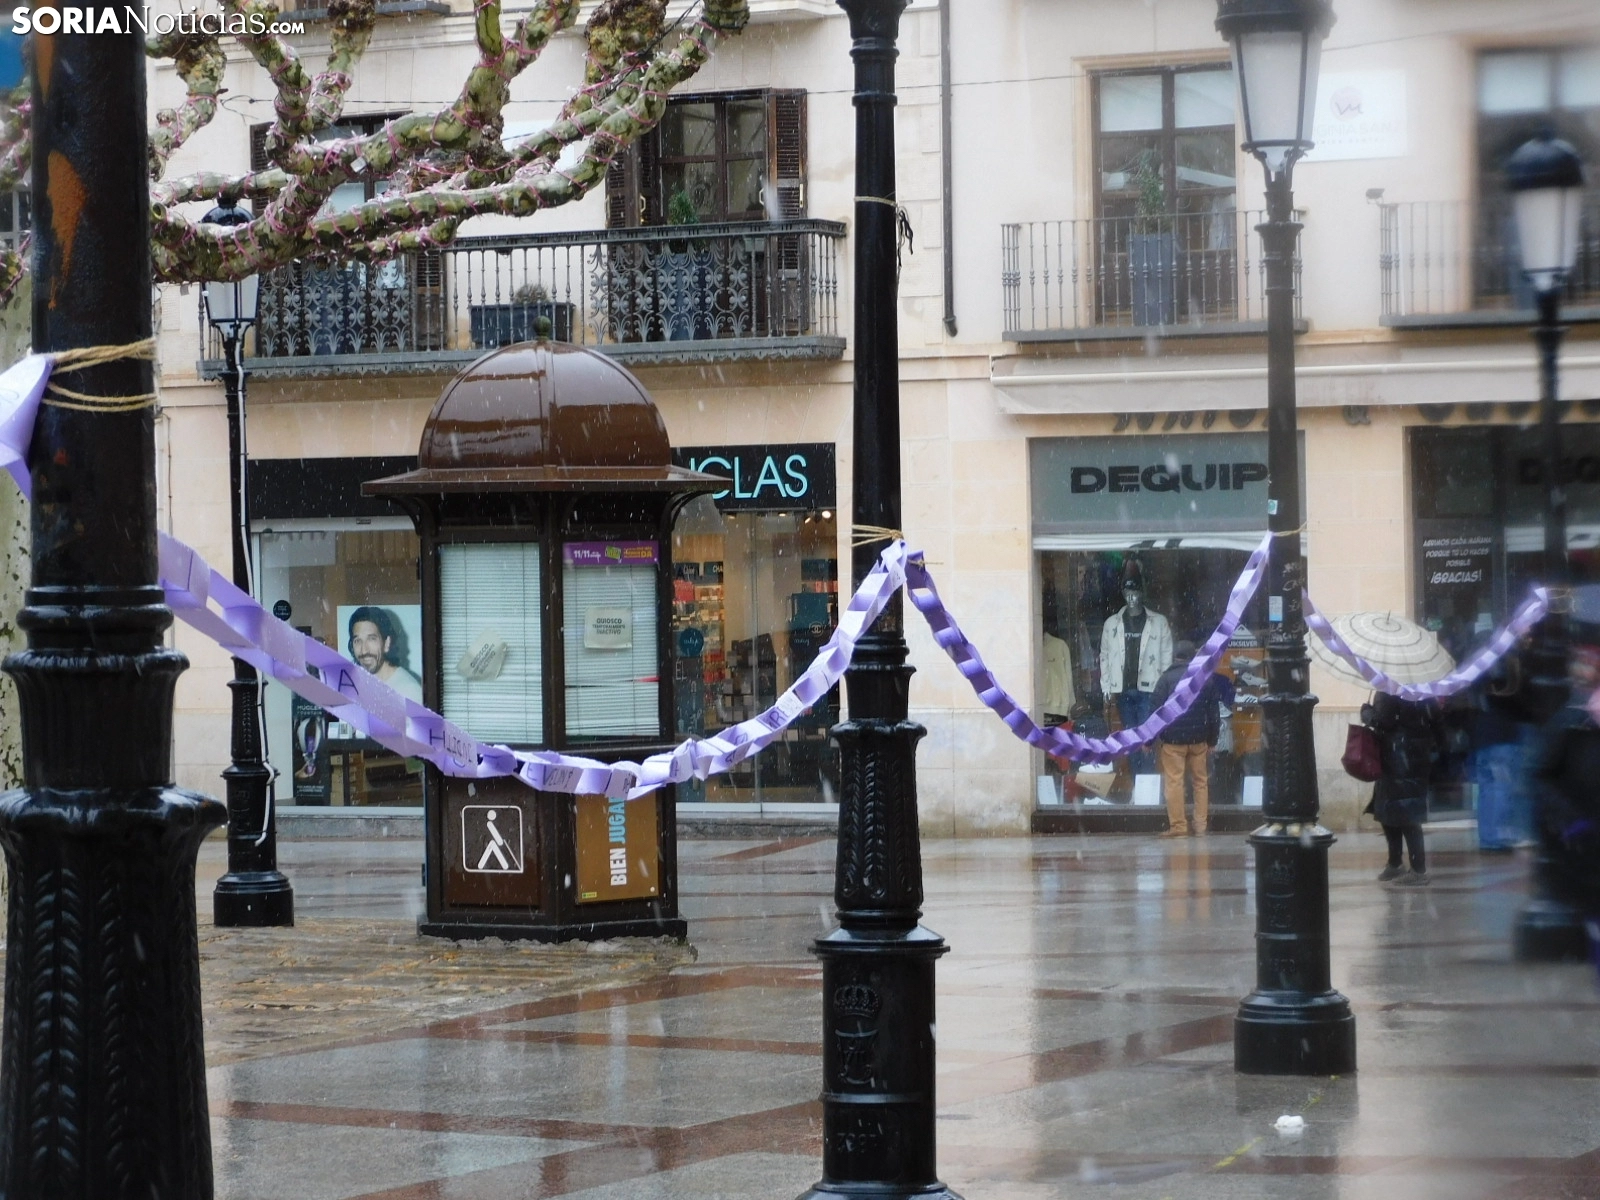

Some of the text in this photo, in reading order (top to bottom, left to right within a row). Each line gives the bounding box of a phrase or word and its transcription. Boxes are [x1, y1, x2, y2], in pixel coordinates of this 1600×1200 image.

[1071, 462, 1269, 494] DEQUIP
[1430, 569, 1482, 584] ¡GRACIAS!
[610, 848, 627, 886] BIEN
